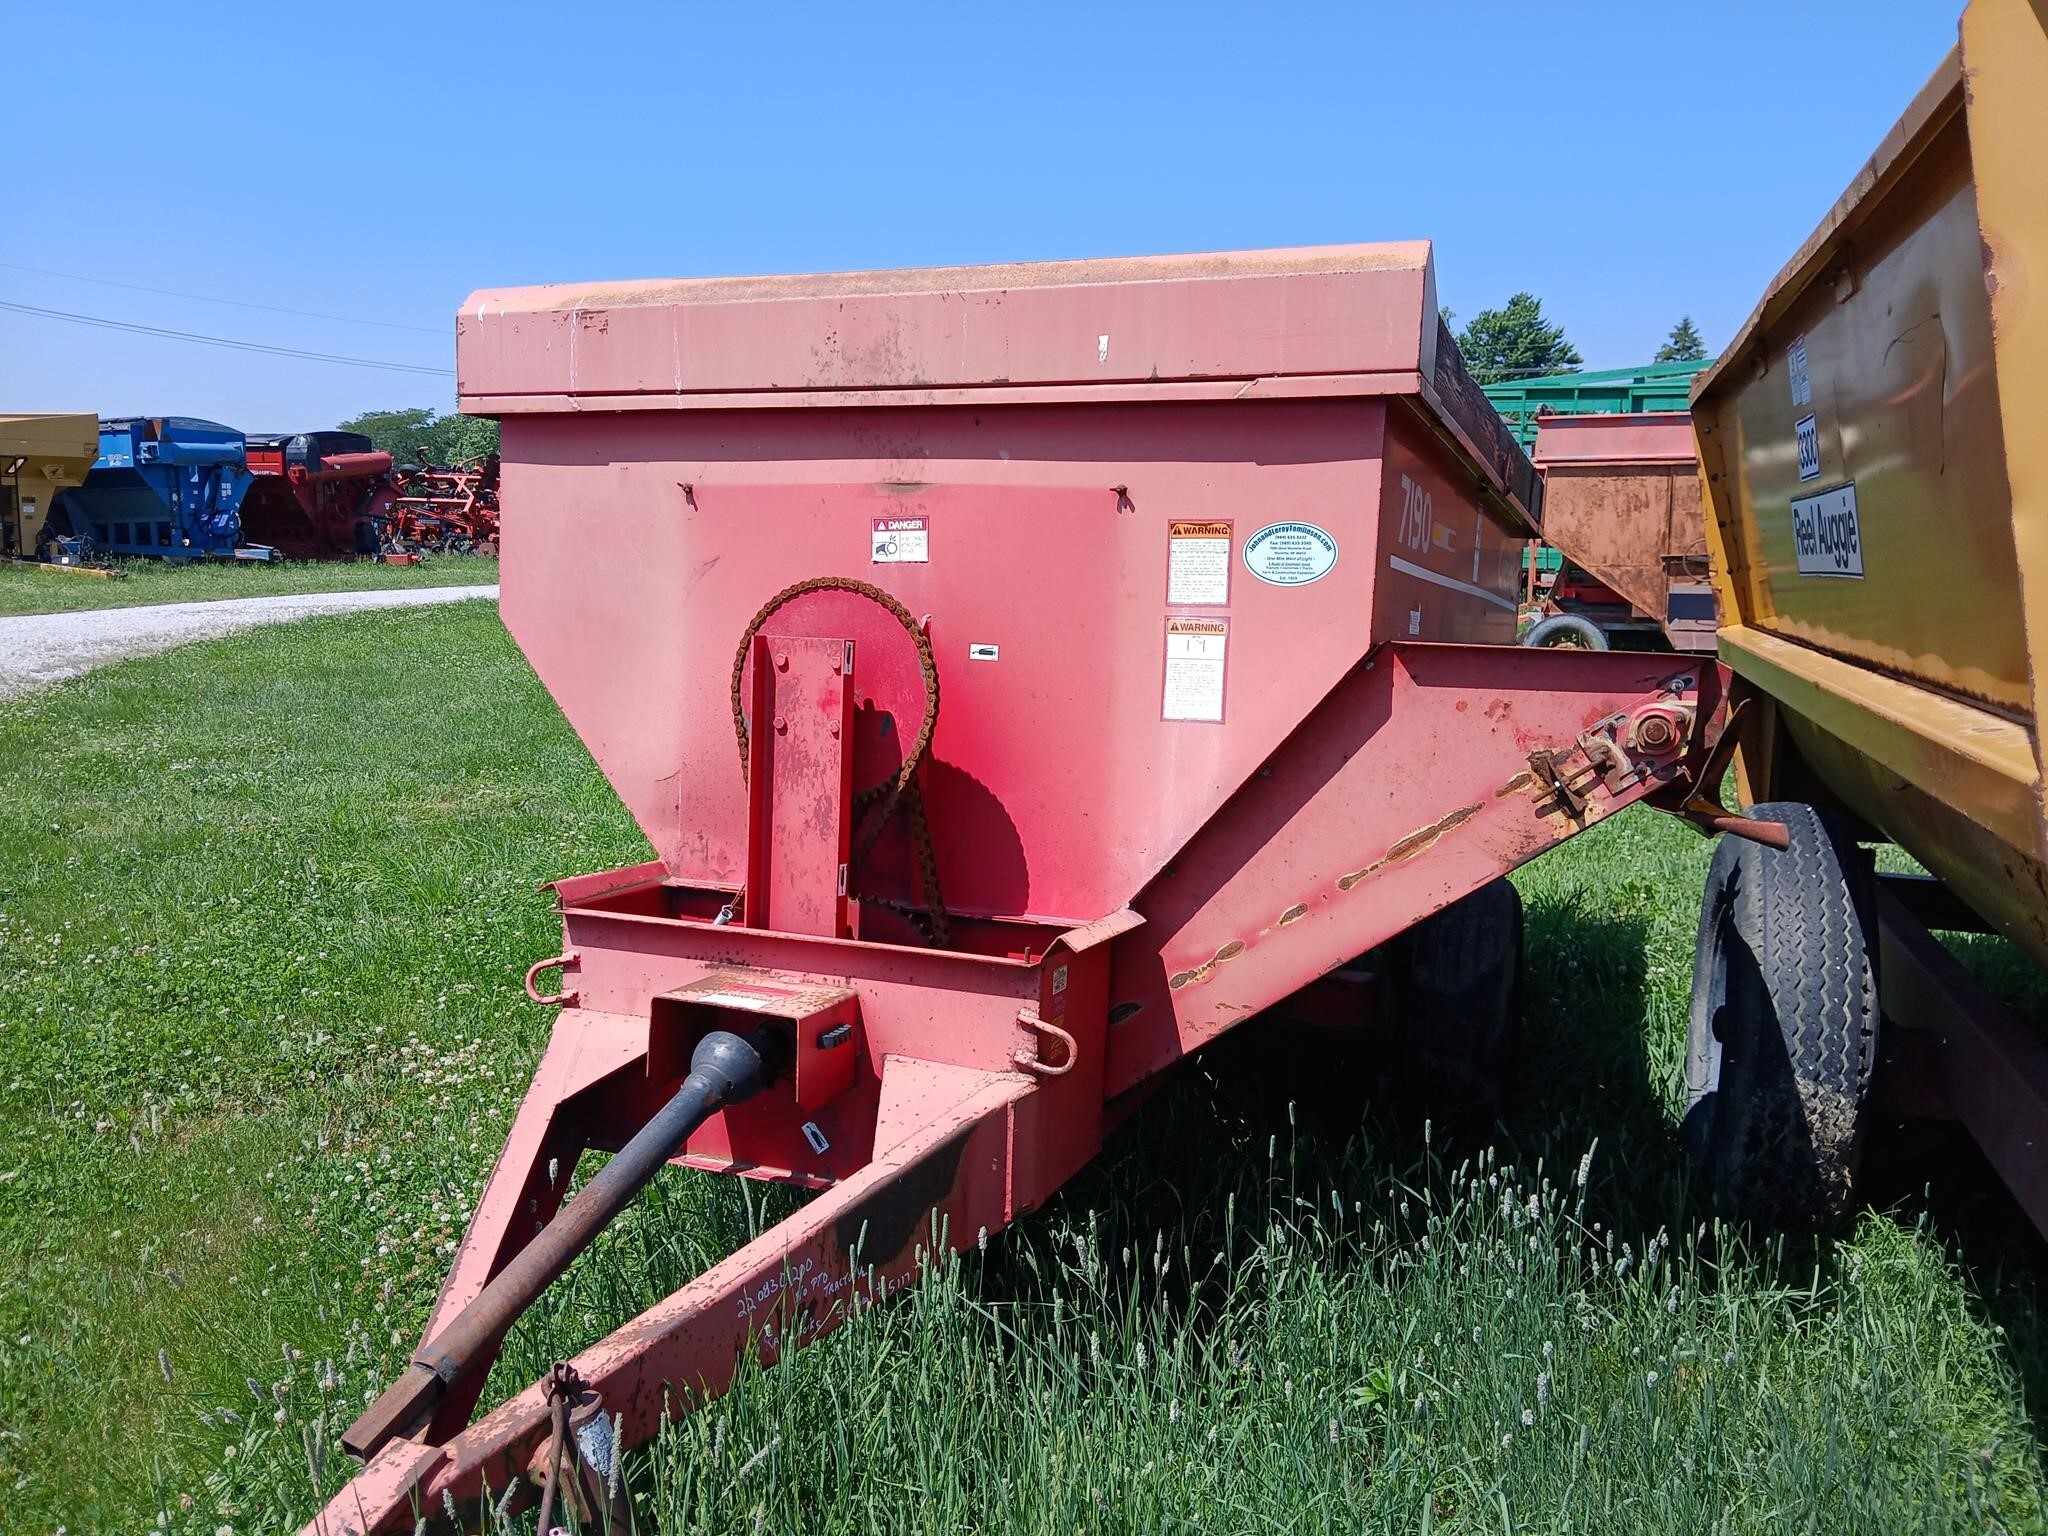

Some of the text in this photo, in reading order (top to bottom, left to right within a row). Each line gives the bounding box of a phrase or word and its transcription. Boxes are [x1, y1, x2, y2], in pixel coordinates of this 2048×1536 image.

[1398, 473, 1432, 554] 7190
[888, 520, 923, 530] DANGER
[1183, 526, 1229, 535] WARNING
[1793, 496, 1857, 570] Reel Auggie
[1180, 623, 1225, 633] WARNING
